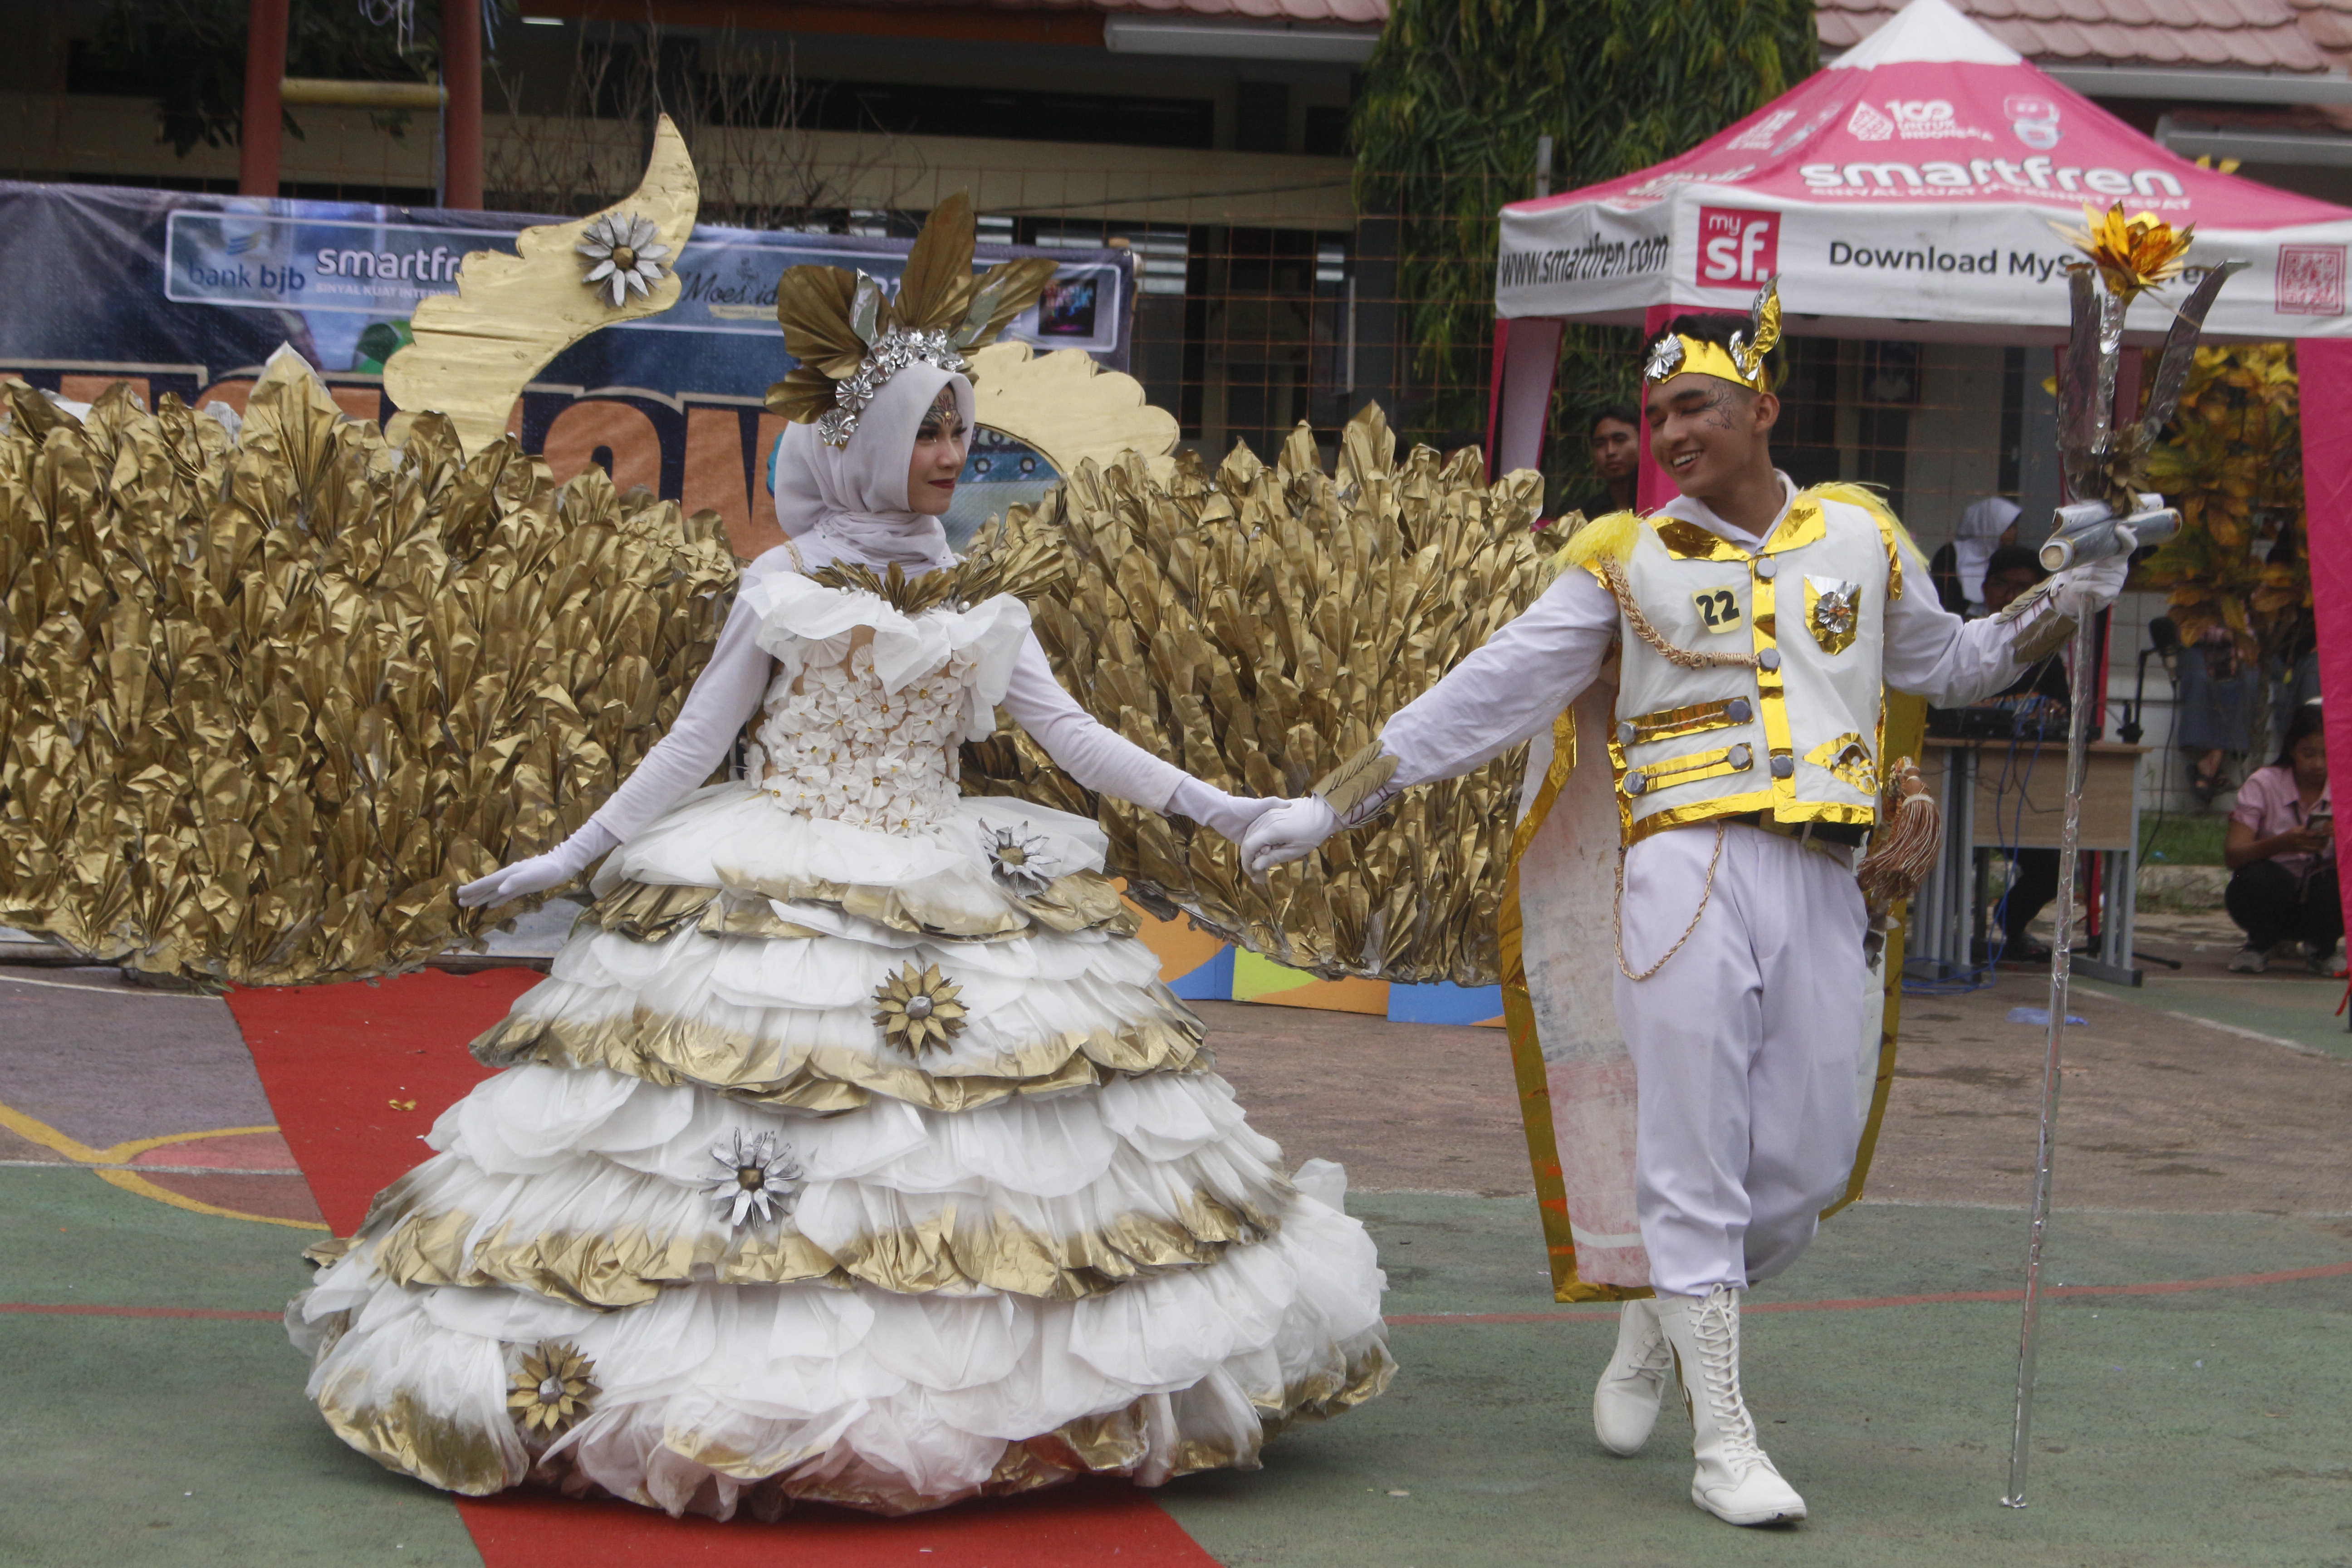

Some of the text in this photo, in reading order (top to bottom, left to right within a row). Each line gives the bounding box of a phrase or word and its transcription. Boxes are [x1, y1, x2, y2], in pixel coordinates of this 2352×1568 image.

[1799, 156, 2184, 197] smartfren
[1709, 214, 1740, 236] my
[316, 246, 460, 282] smartfr
[1501, 232, 1668, 288] www.smartfren.com
[1829, 241, 1997, 274] Download
[187, 261, 305, 294] bank bjb
[1696, 591, 1740, 626] 22
